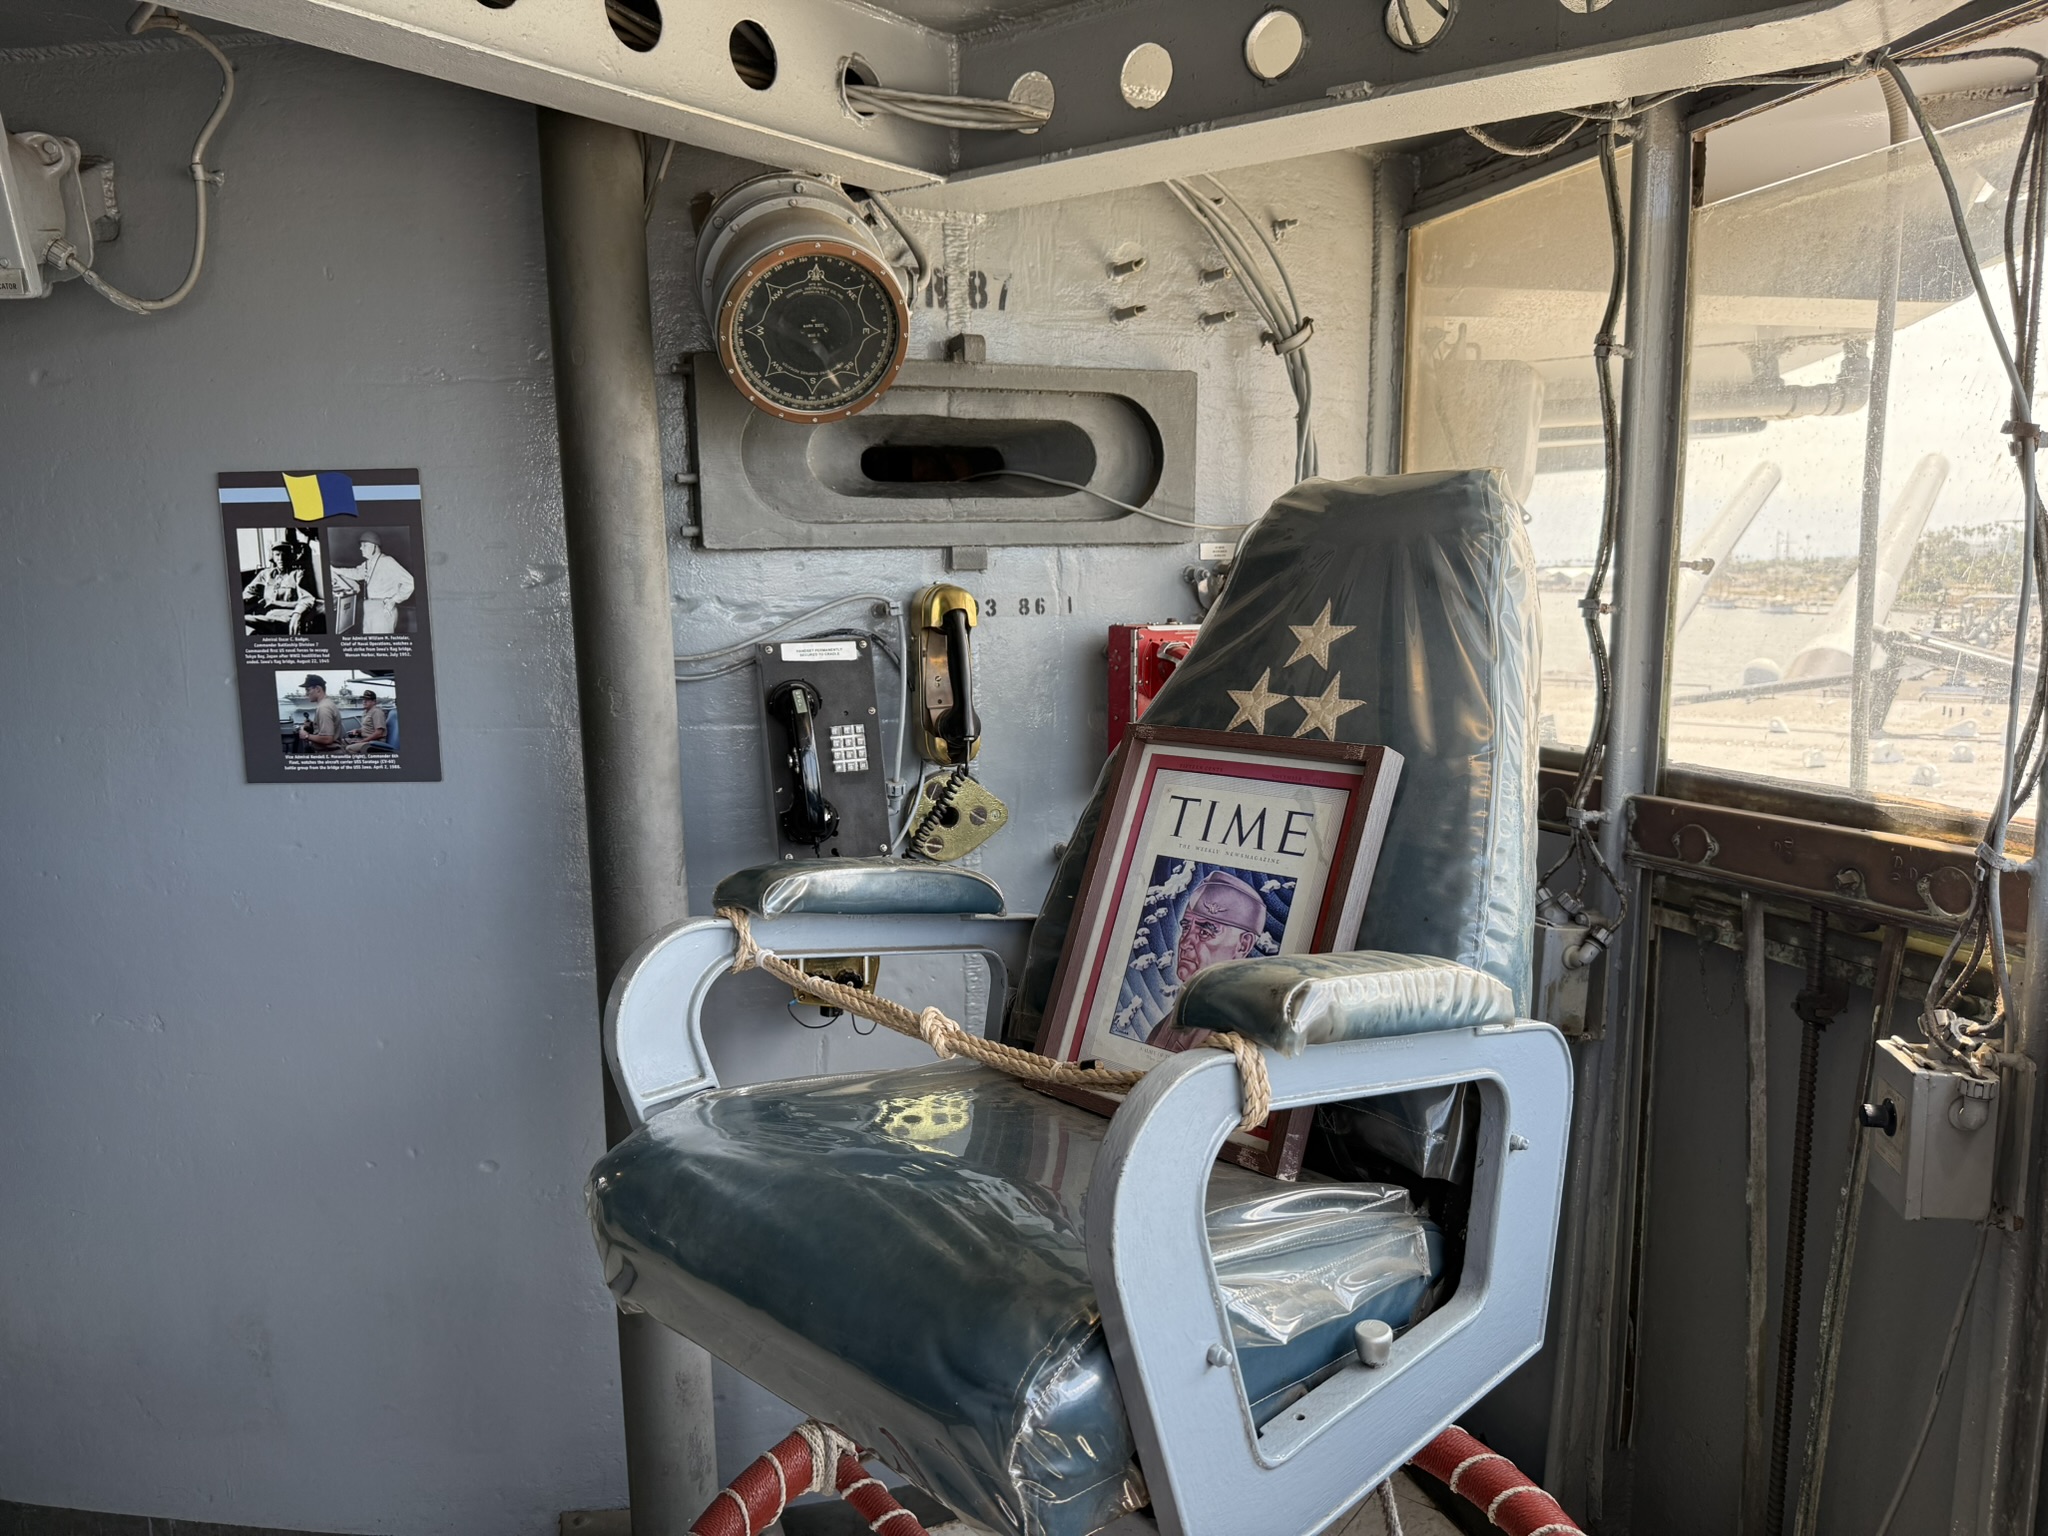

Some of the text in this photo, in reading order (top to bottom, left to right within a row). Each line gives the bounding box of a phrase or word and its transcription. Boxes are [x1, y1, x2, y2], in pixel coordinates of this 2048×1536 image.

[771, 288, 783, 301] NW
[846, 290, 857, 300] NE
[757, 325, 764, 335] W
[975, 598, 996, 617] 3
[1019, 597, 1045, 615] 86
[1169, 795, 1314, 857] TIME
[1195, 846, 1220, 855] WEEKLY
[1225, 851, 1280, 864] NEWSMAGAZINE
